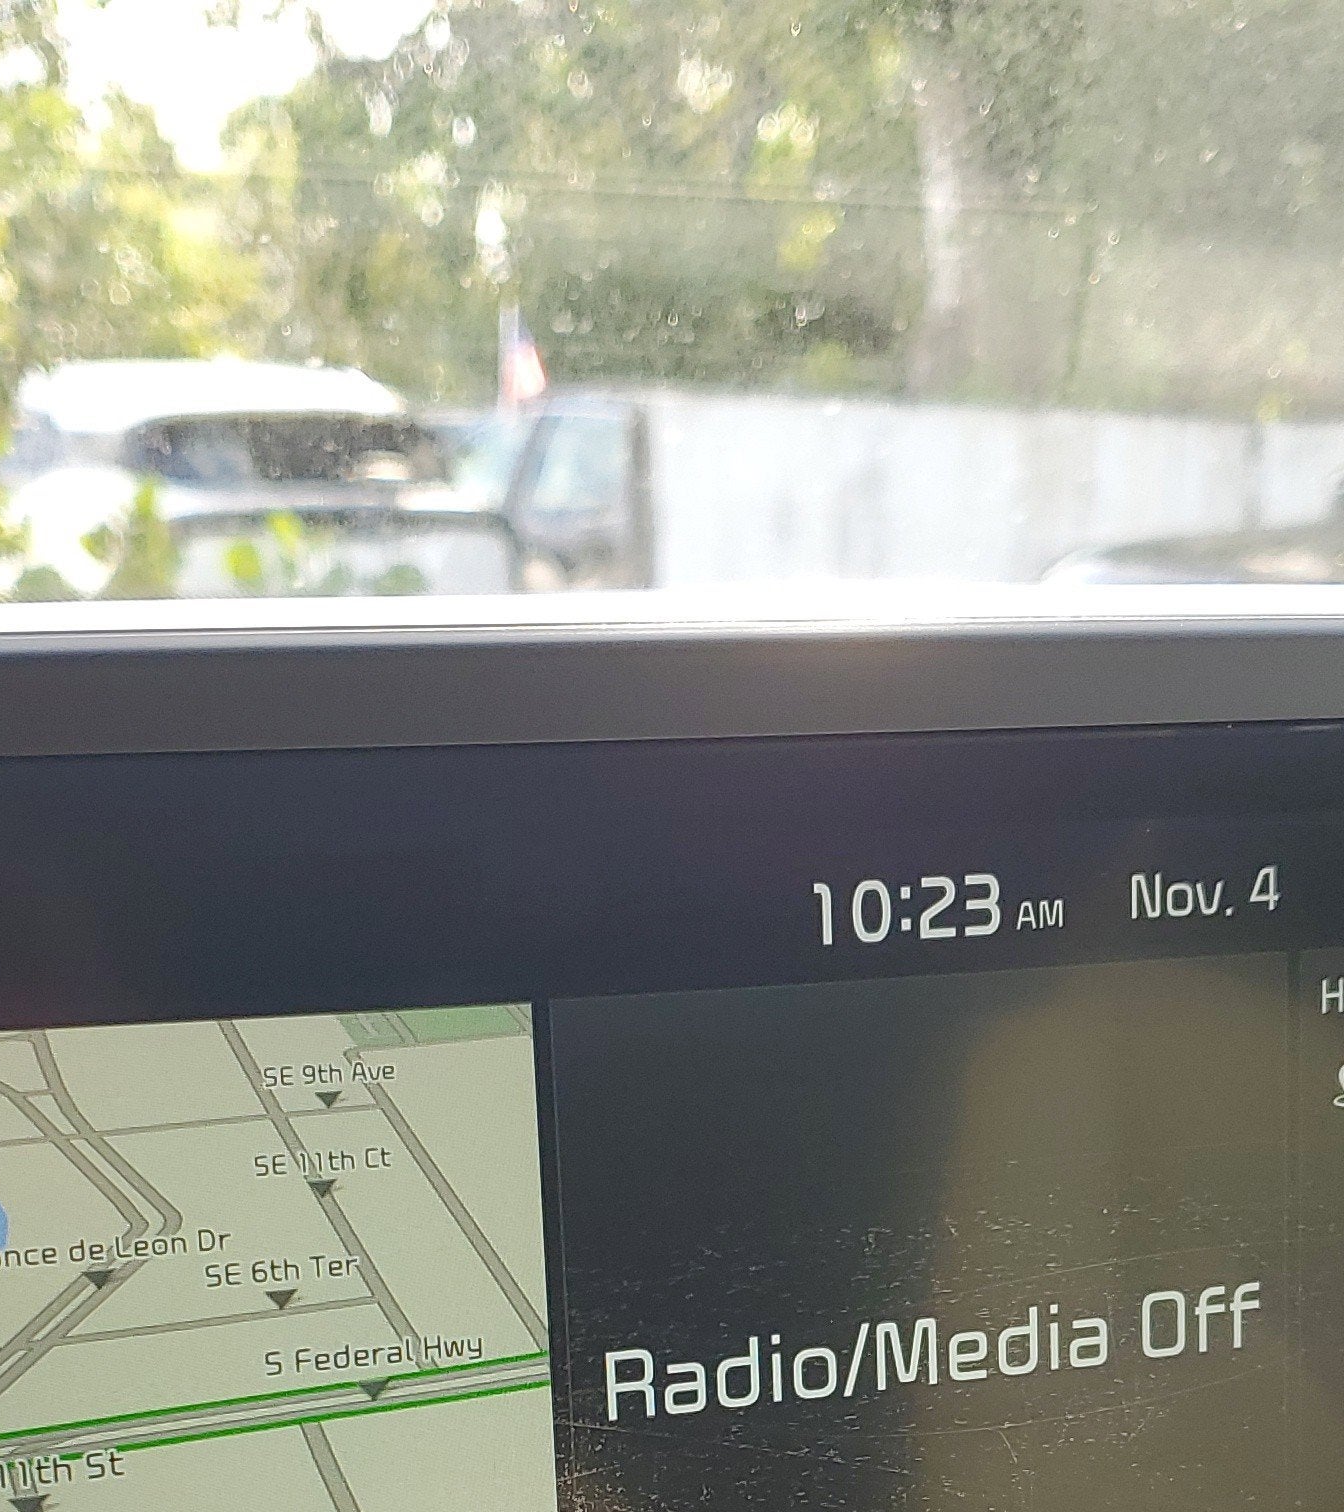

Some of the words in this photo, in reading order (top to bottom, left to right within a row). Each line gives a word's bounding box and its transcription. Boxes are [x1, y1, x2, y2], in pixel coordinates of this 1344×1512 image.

[813, 873, 1002, 945] 10:23
[1015, 900, 1065, 931] AM
[1130, 872, 1235, 919] Nov.
[1250, 865, 1280, 912] 4
[262, 1065, 294, 1087] SE
[302, 1063, 343, 1084] 9th
[351, 1062, 396, 1081] Ave
[254, 1154, 287, 1177] SE
[301, 1150, 356, 1174] 11th
[364, 1147, 392, 1169] Ct
[68, 1240, 105, 1264] de
[115, 1234, 187, 1259] Leon
[197, 1229, 232, 1253] Dr
[205, 1263, 242, 1288] SE
[251, 1258, 301, 1283] 6th
[309, 1254, 359, 1278] Ter
[264, 1351, 283, 1376] S
[295, 1339, 414, 1374] Federal
[423, 1334, 484, 1362] Hwy
[605, 1304, 1109, 1422] Radio/Media
[1141, 1281, 1261, 1360] Off
[85, 1449, 126, 1478] St
